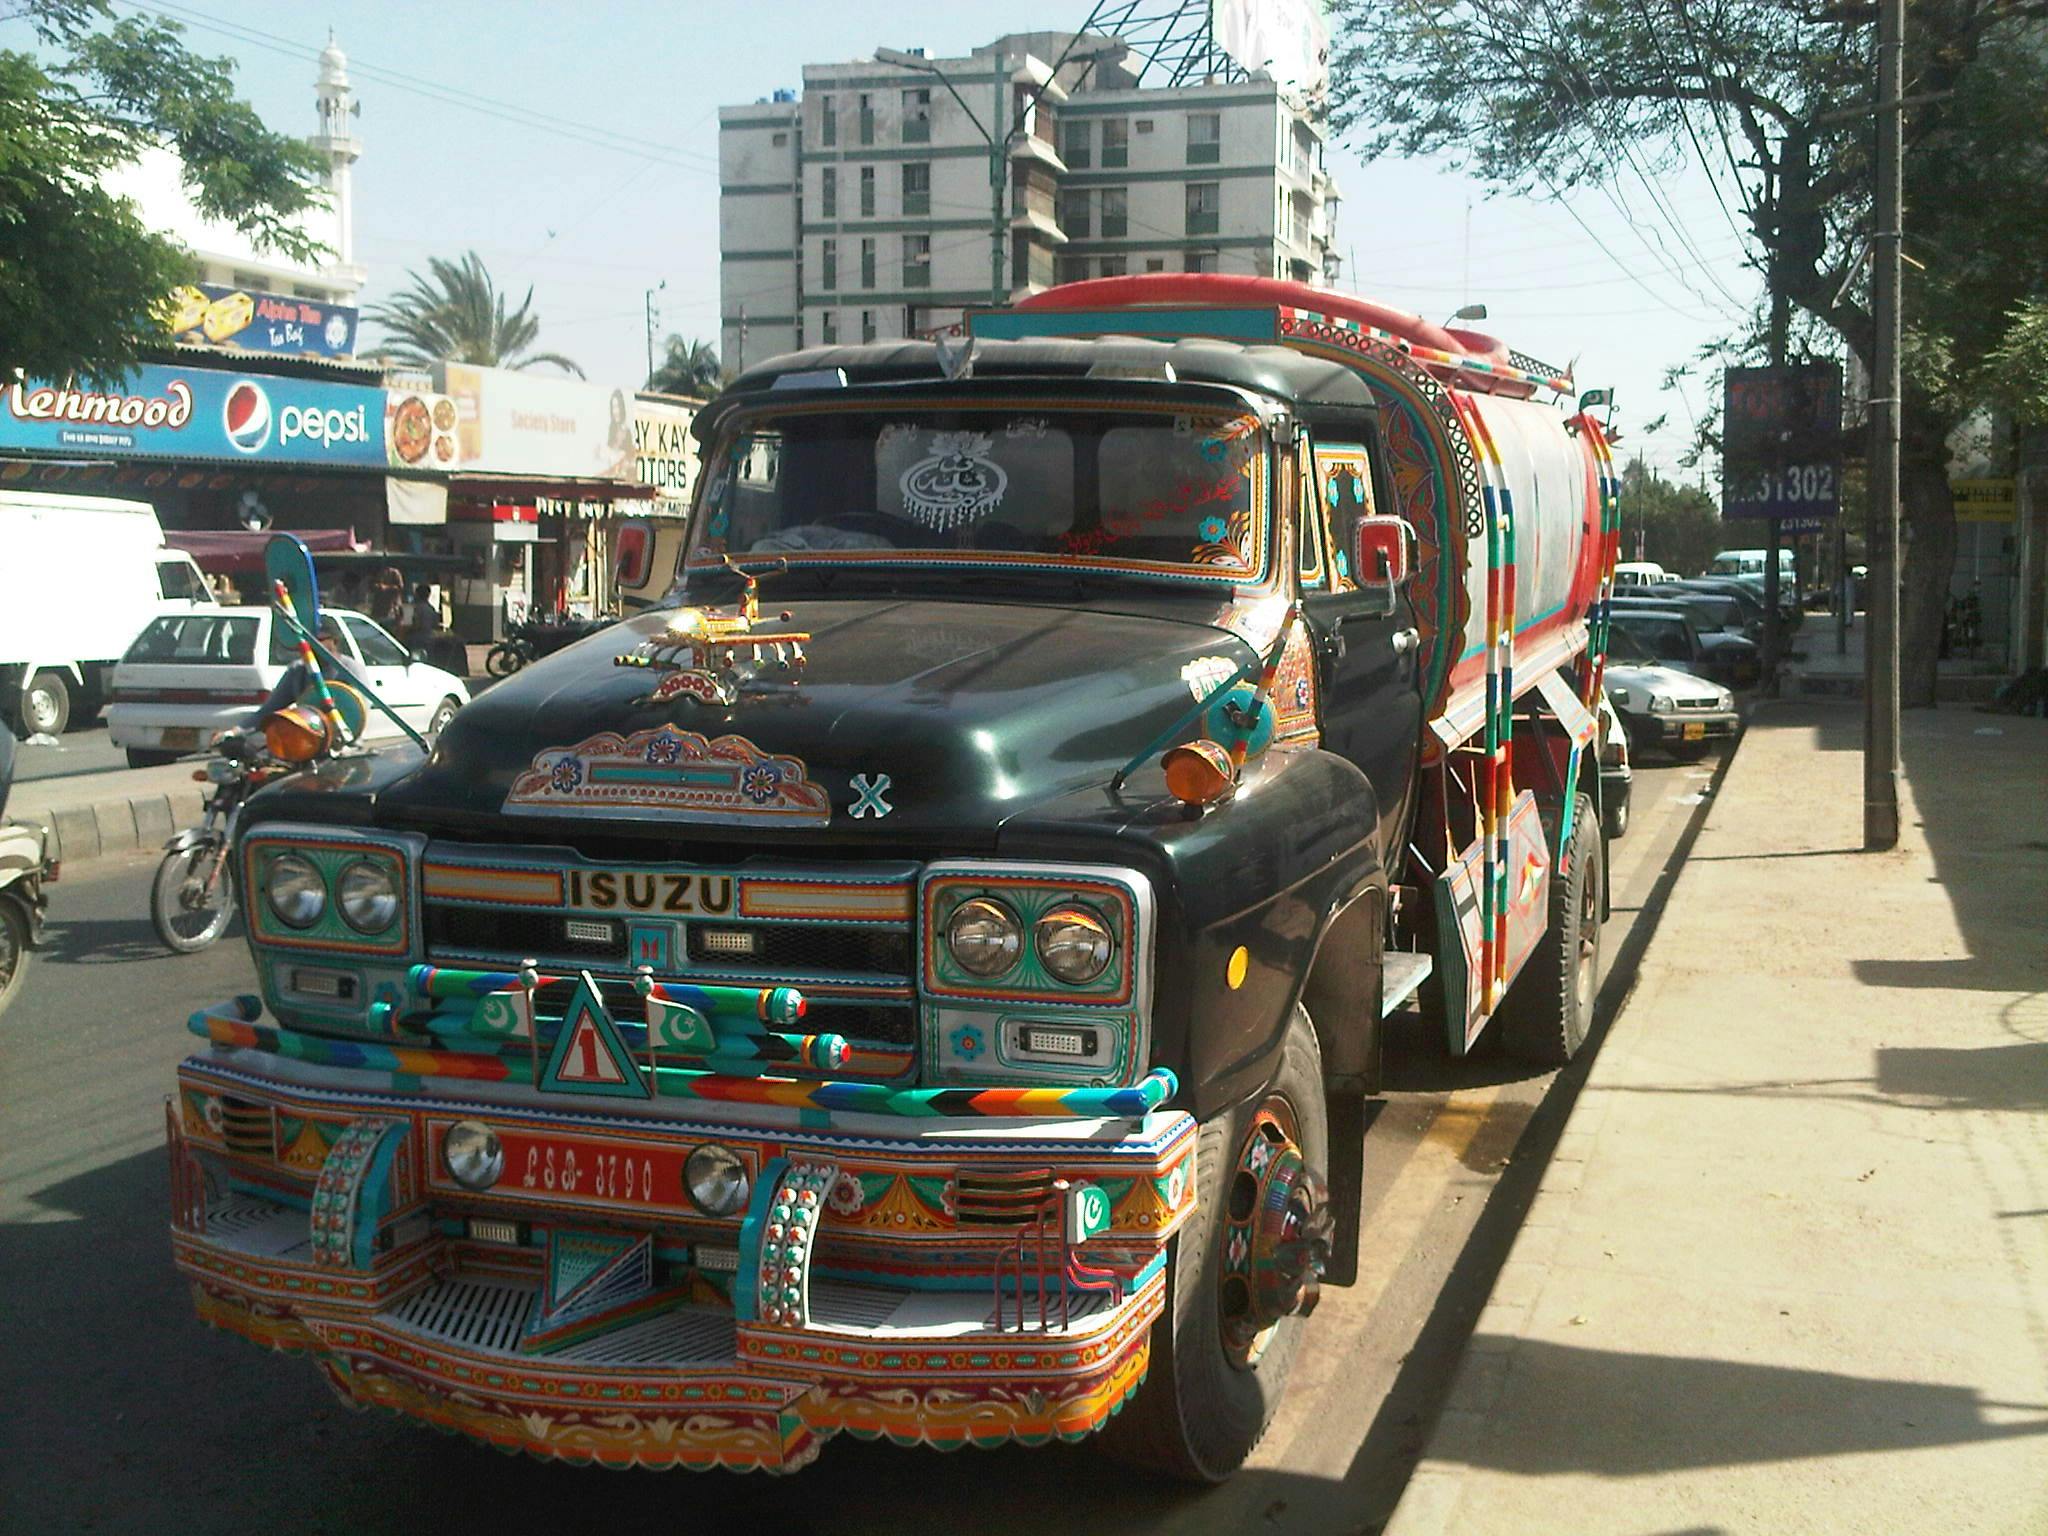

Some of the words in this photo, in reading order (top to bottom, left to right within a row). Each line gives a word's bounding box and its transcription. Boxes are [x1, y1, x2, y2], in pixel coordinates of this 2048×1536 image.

[280, 404, 366, 449] pepsi
[658, 422, 688, 455] KAY
[570, 870, 734, 914] ISUZU
[577, 1028, 601, 1077] 1
